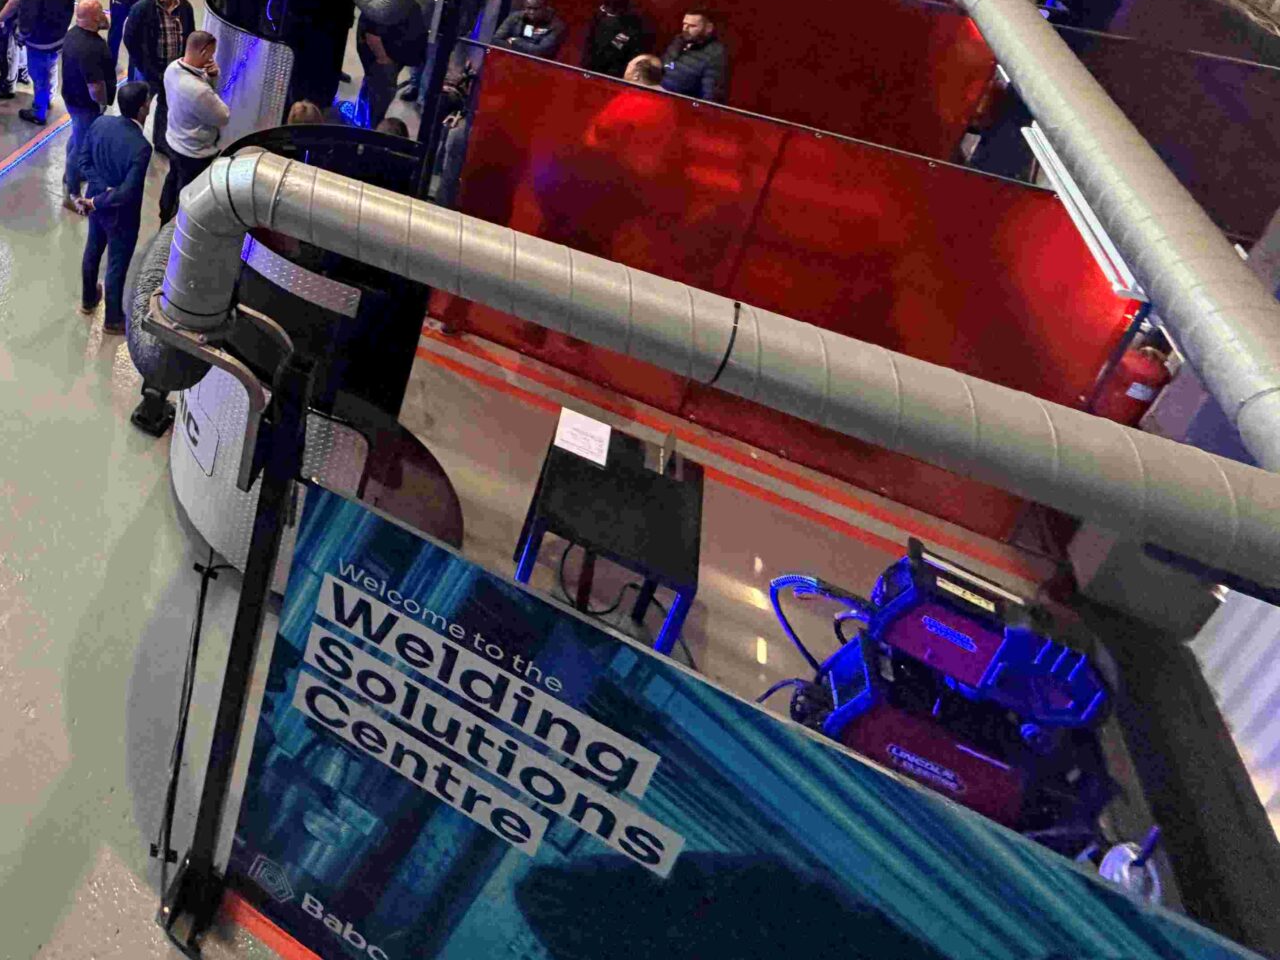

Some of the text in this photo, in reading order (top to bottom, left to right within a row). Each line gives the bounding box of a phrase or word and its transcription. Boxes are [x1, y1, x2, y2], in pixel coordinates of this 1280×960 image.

[331, 581, 641, 793] Welding
[337, 557, 564, 694] Welcome to the
[304, 684, 533, 846] Centre
[313, 635, 666, 867] Solutions
